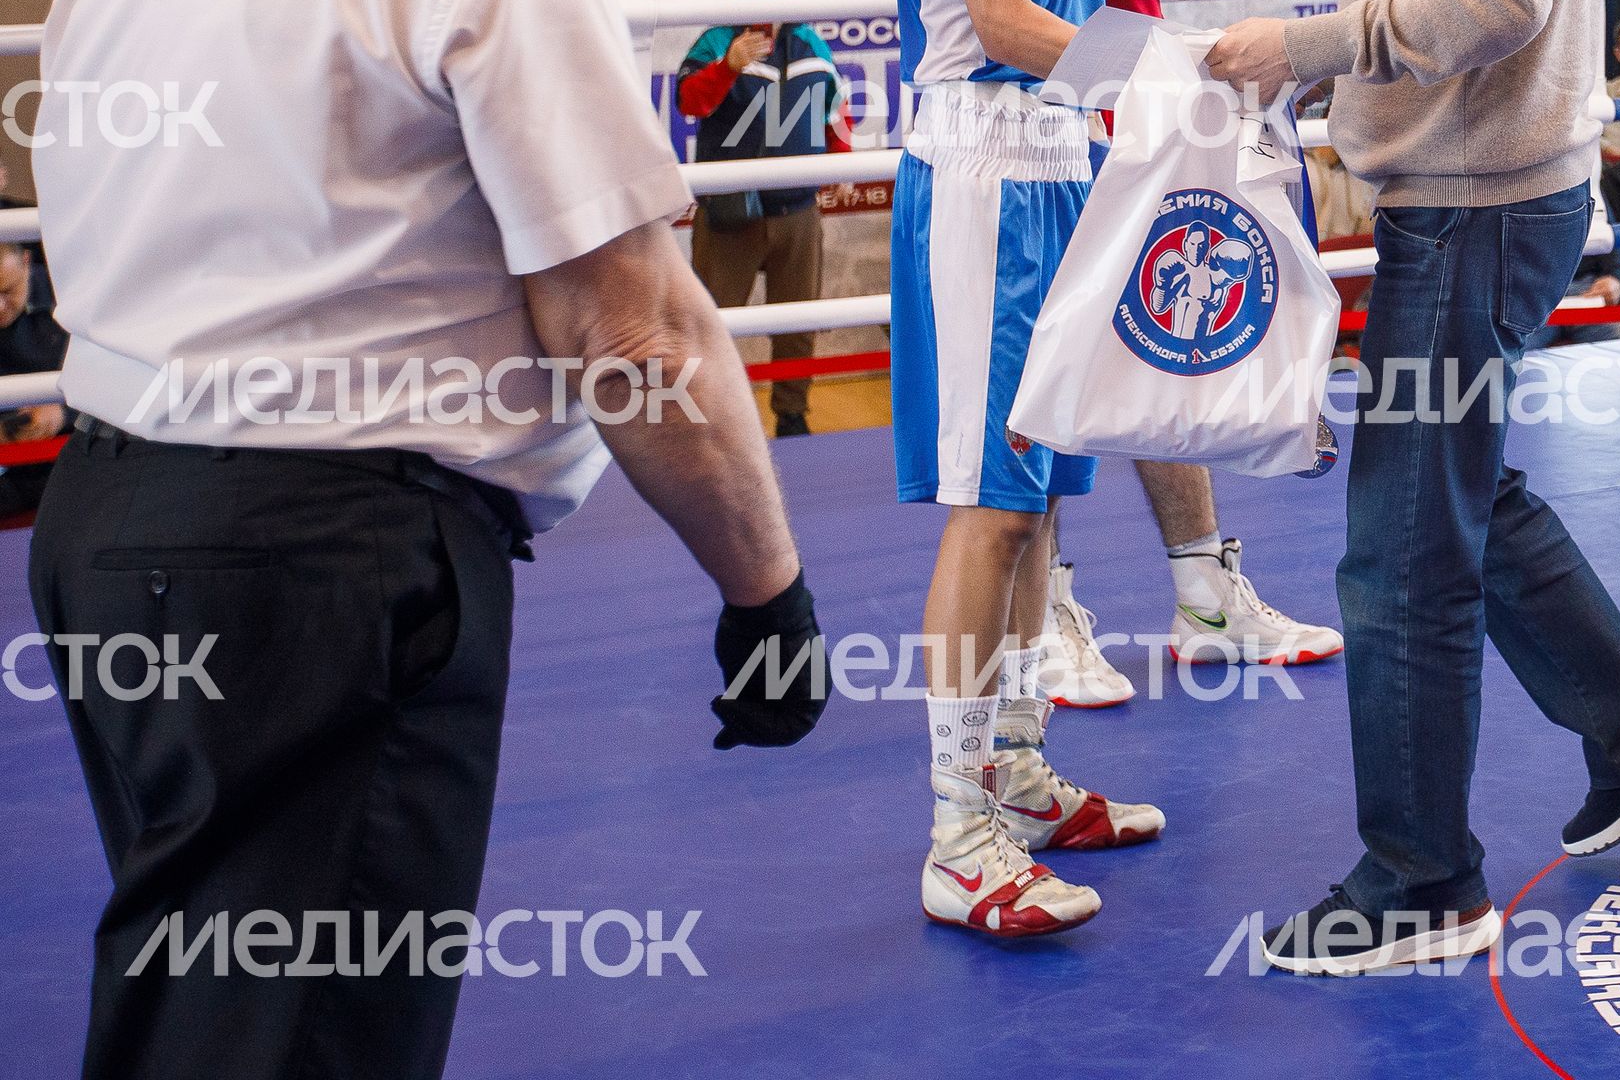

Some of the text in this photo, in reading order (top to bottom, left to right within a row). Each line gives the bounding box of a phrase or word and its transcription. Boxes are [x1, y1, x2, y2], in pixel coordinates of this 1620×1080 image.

[815, 17, 900, 46] РОС
[1119, 303, 1187, 364] АЛЕКСАНДРА
[1014, 870, 1035, 889] NIKE
